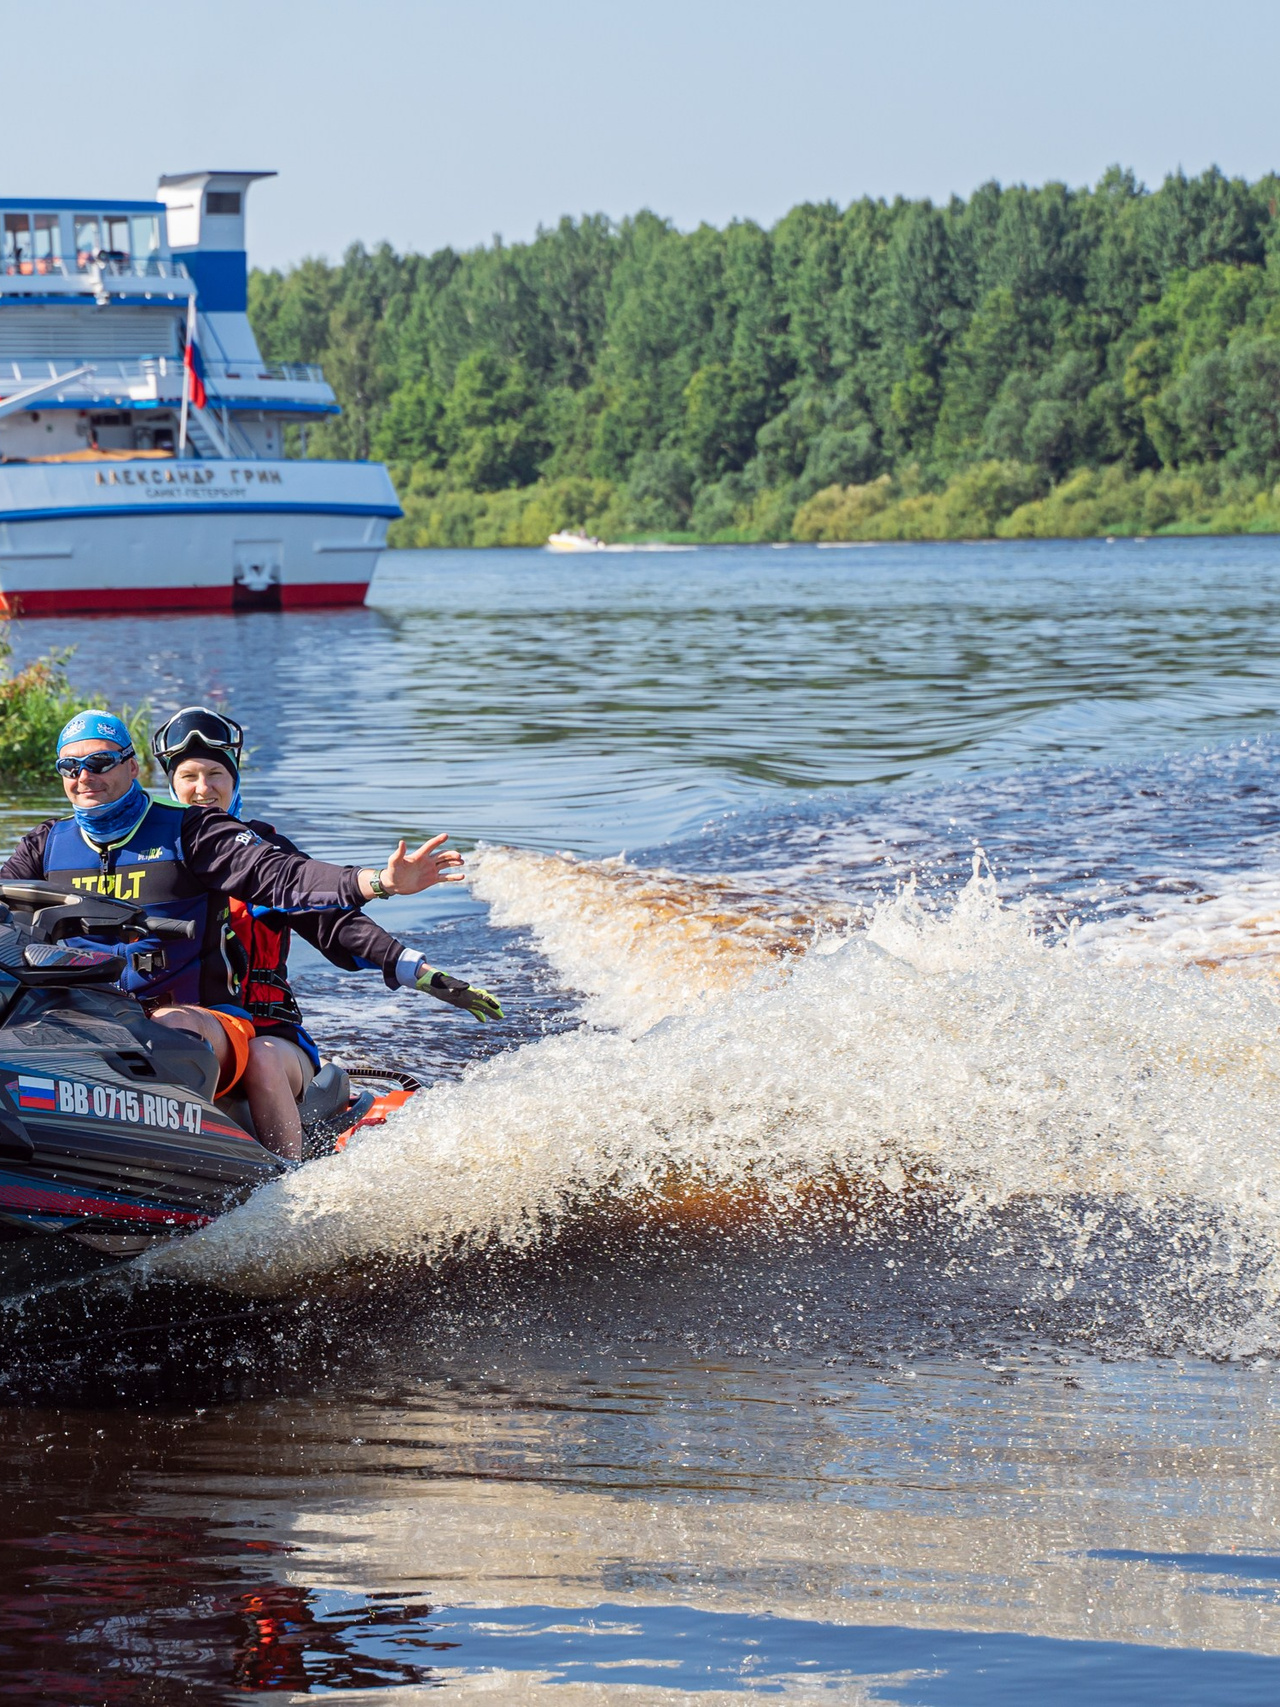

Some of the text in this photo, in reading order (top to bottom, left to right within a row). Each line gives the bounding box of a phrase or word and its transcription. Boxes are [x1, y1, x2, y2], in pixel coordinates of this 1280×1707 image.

[95, 469, 283, 486] АЛЕКСАНДР ГРИН
[145, 487, 247, 499] САНКТ-ПЕТЕРБУРГ
[58, 1080, 202, 1135] BB 0715 RUS 47
